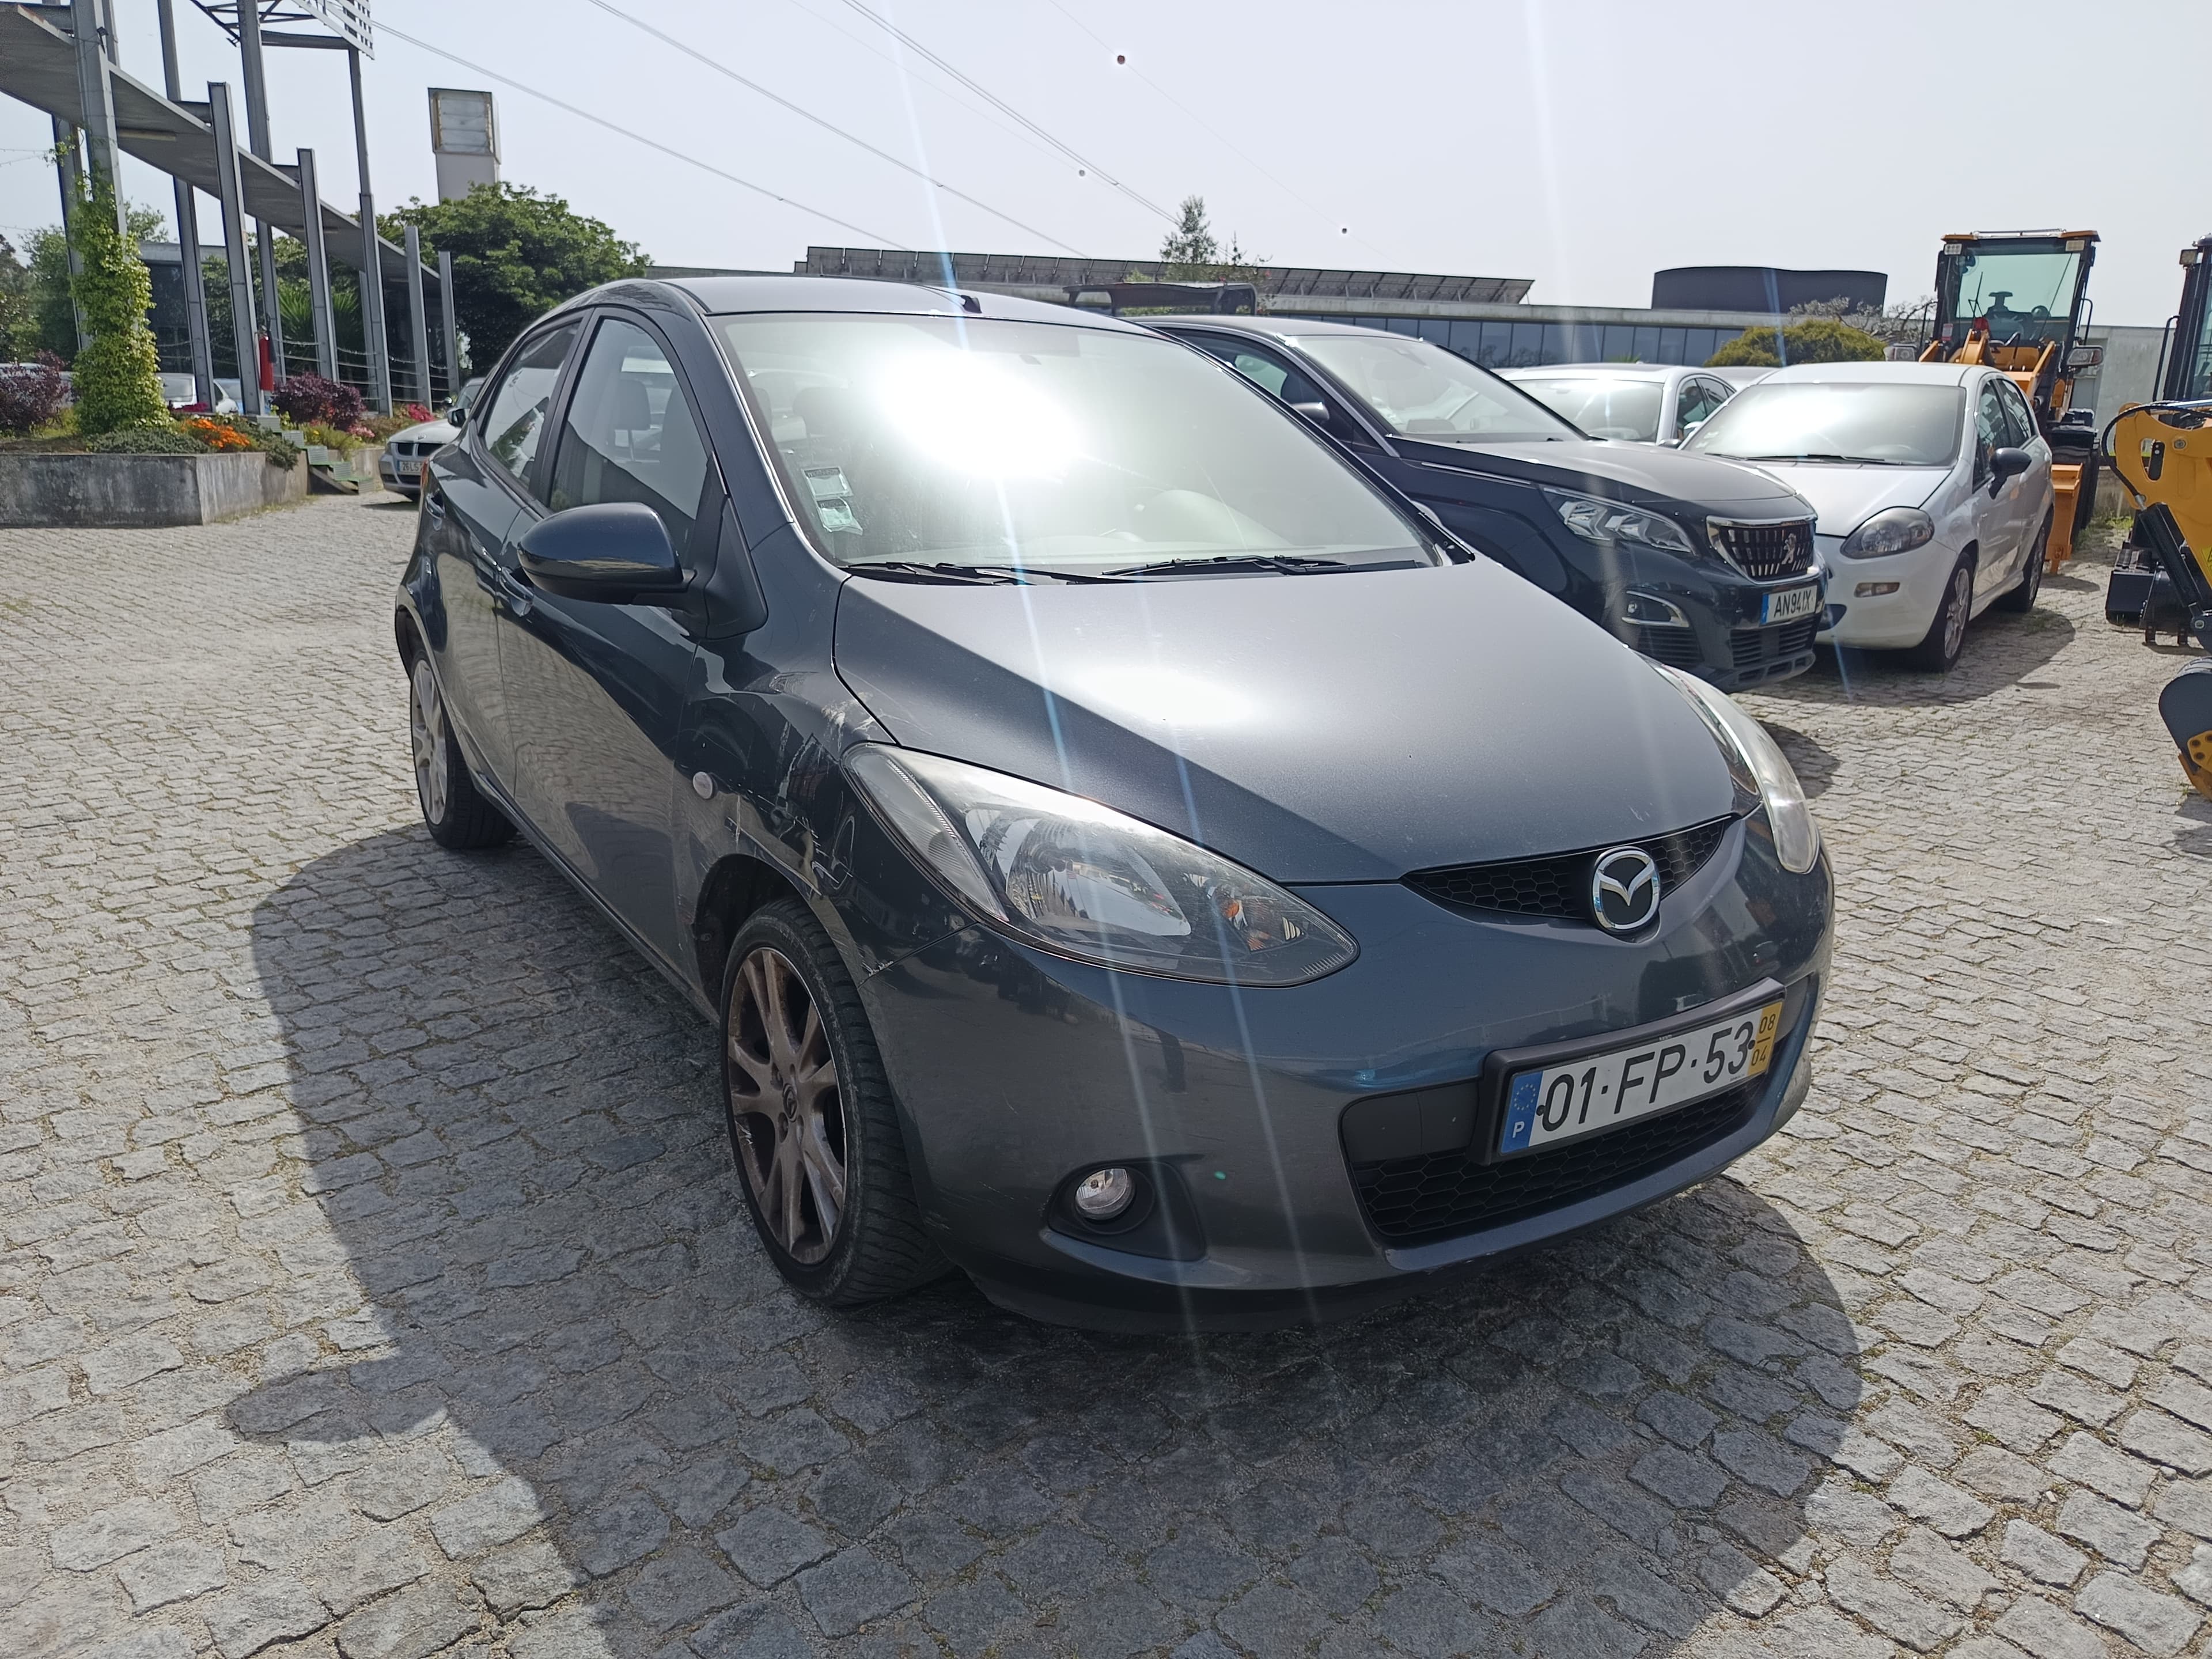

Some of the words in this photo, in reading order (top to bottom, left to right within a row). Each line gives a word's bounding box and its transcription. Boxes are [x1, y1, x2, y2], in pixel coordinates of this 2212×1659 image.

[1759, 1013, 1776, 1035] 08
[1752, 1048, 1767, 1066] 04
[1512, 1121, 1525, 1138] P
